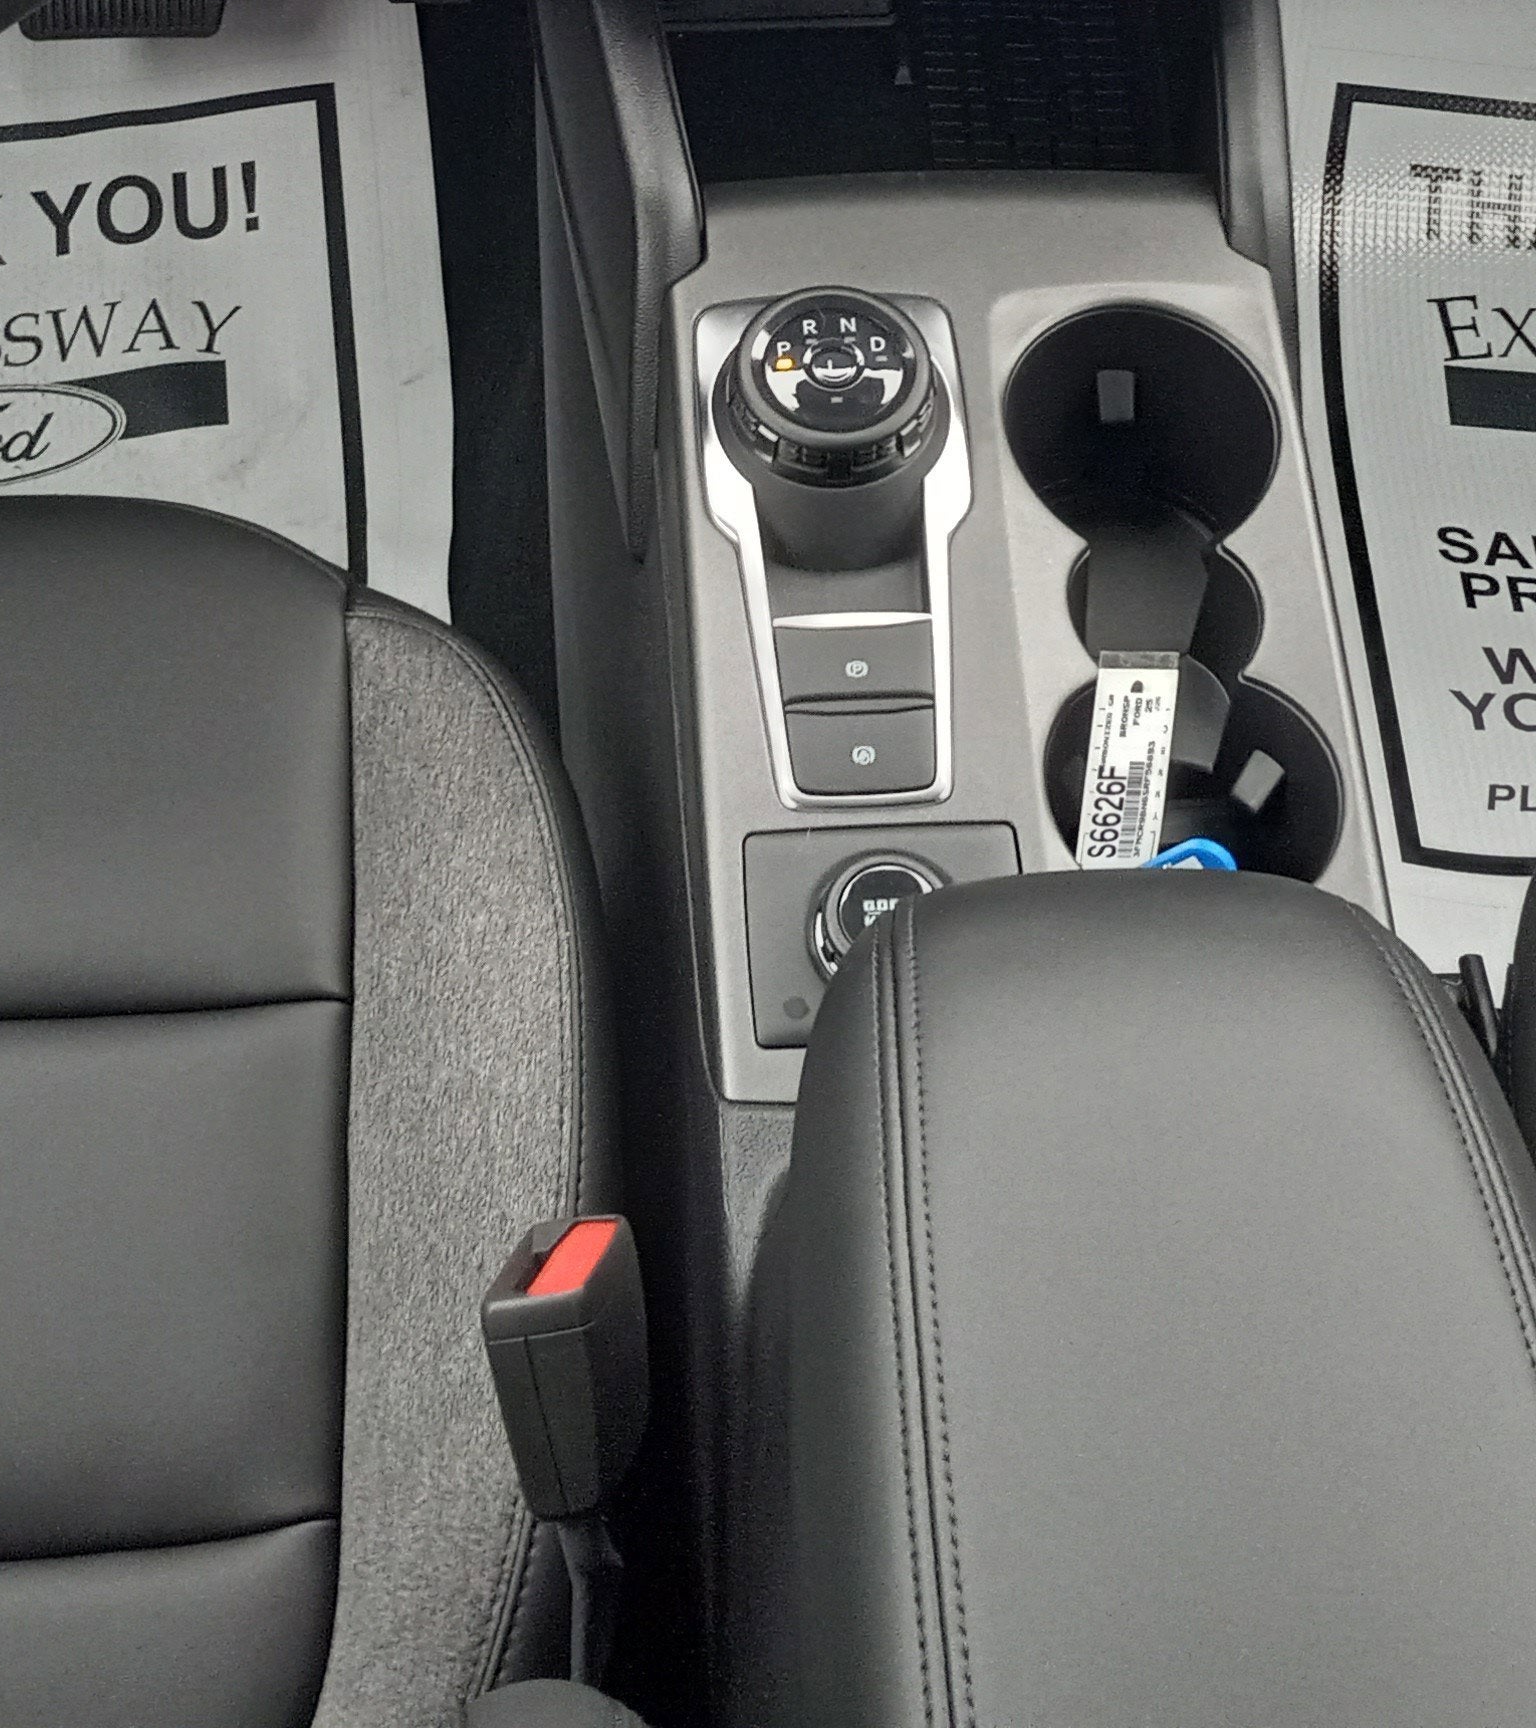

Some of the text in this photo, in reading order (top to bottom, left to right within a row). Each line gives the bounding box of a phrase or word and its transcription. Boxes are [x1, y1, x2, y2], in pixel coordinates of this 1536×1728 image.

[31, 160, 261, 257] YOU!
[802, 319, 818, 334] R
[840, 317, 857, 333] N
[777, 341, 792, 356] P
[870, 336, 886, 352] D
[1133, 697, 1143, 726] FORD
[1087, 765, 1127, 858] S6626F
